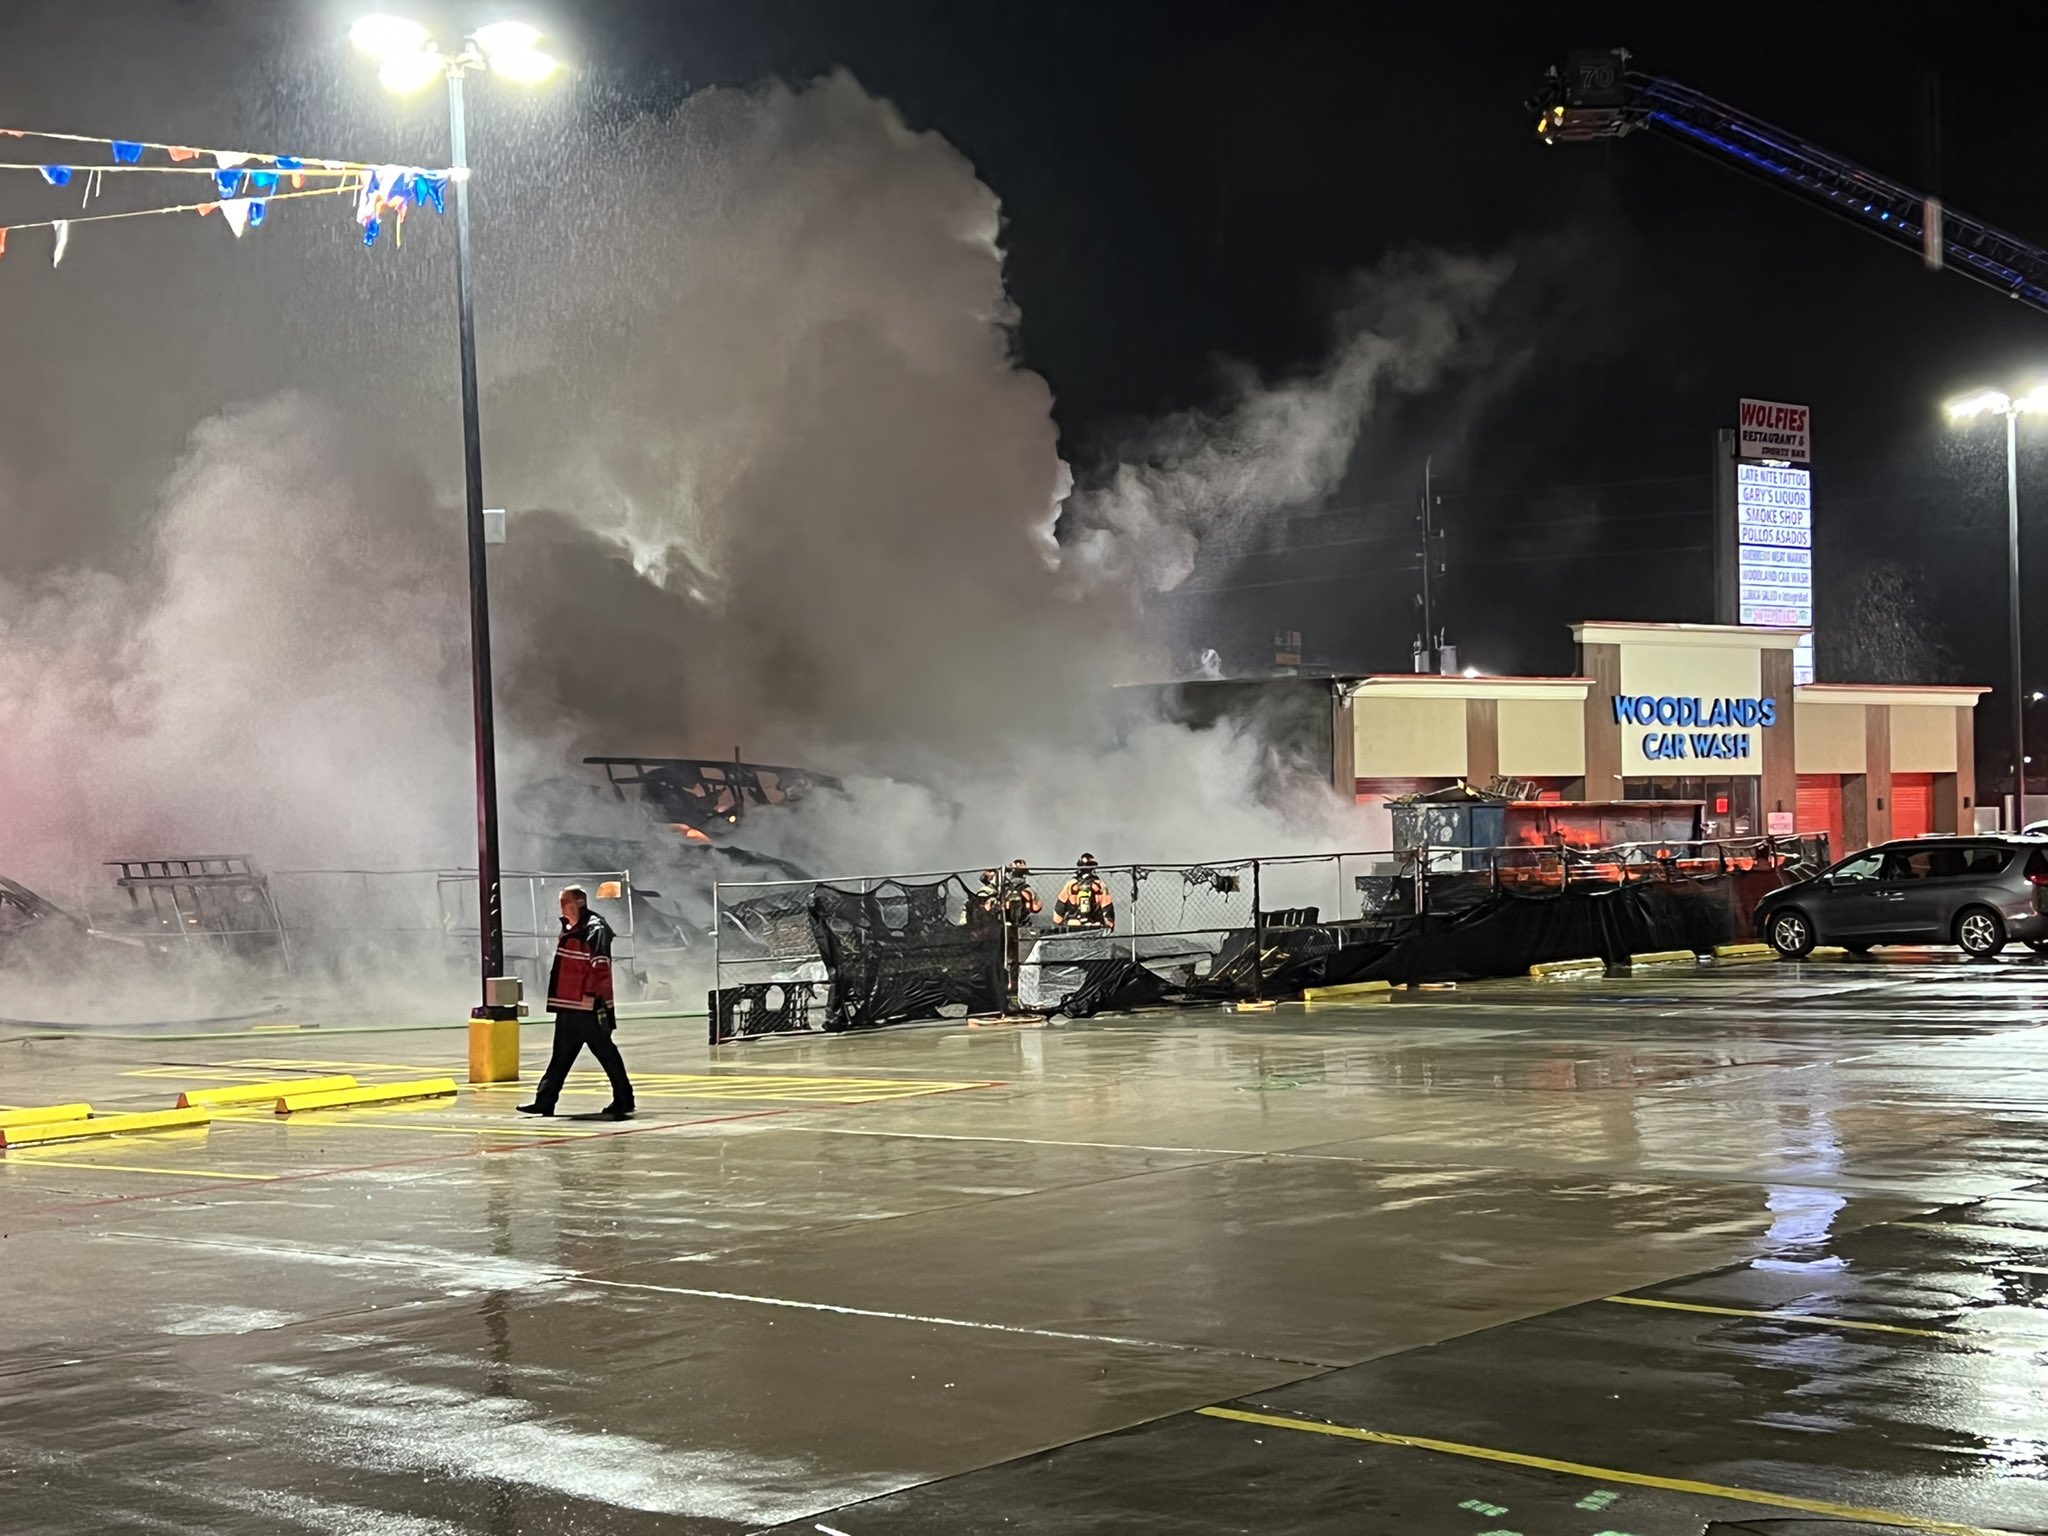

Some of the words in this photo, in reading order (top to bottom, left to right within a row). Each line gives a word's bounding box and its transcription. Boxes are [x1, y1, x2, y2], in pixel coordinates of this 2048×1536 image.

[1580, 65, 1614, 88] 70
[1741, 403, 1807, 432] WOLFIES
[1742, 430, 1797, 445] RESTAURANT
[1761, 446, 1789, 457] SPORTS
[1791, 449, 1806, 458] BAR
[1740, 467, 1759, 482] LATE
[1760, 470, 1778, 484] NITE
[1779, 471, 1807, 487] TATTOO
[1743, 487, 1774, 503] GARY'S
[1774, 490, 1806, 506] LIQUOR
[1746, 507, 1777, 523] SMOKE
[1779, 510, 1804, 525] SHOP
[1742, 527, 1773, 542] POLLOS
[1775, 529, 1808, 546] ASADOS
[1611, 695, 1777, 728] WOODLANDS
[1642, 732, 1687, 760] CAR
[1689, 732, 1750, 759] WASH
